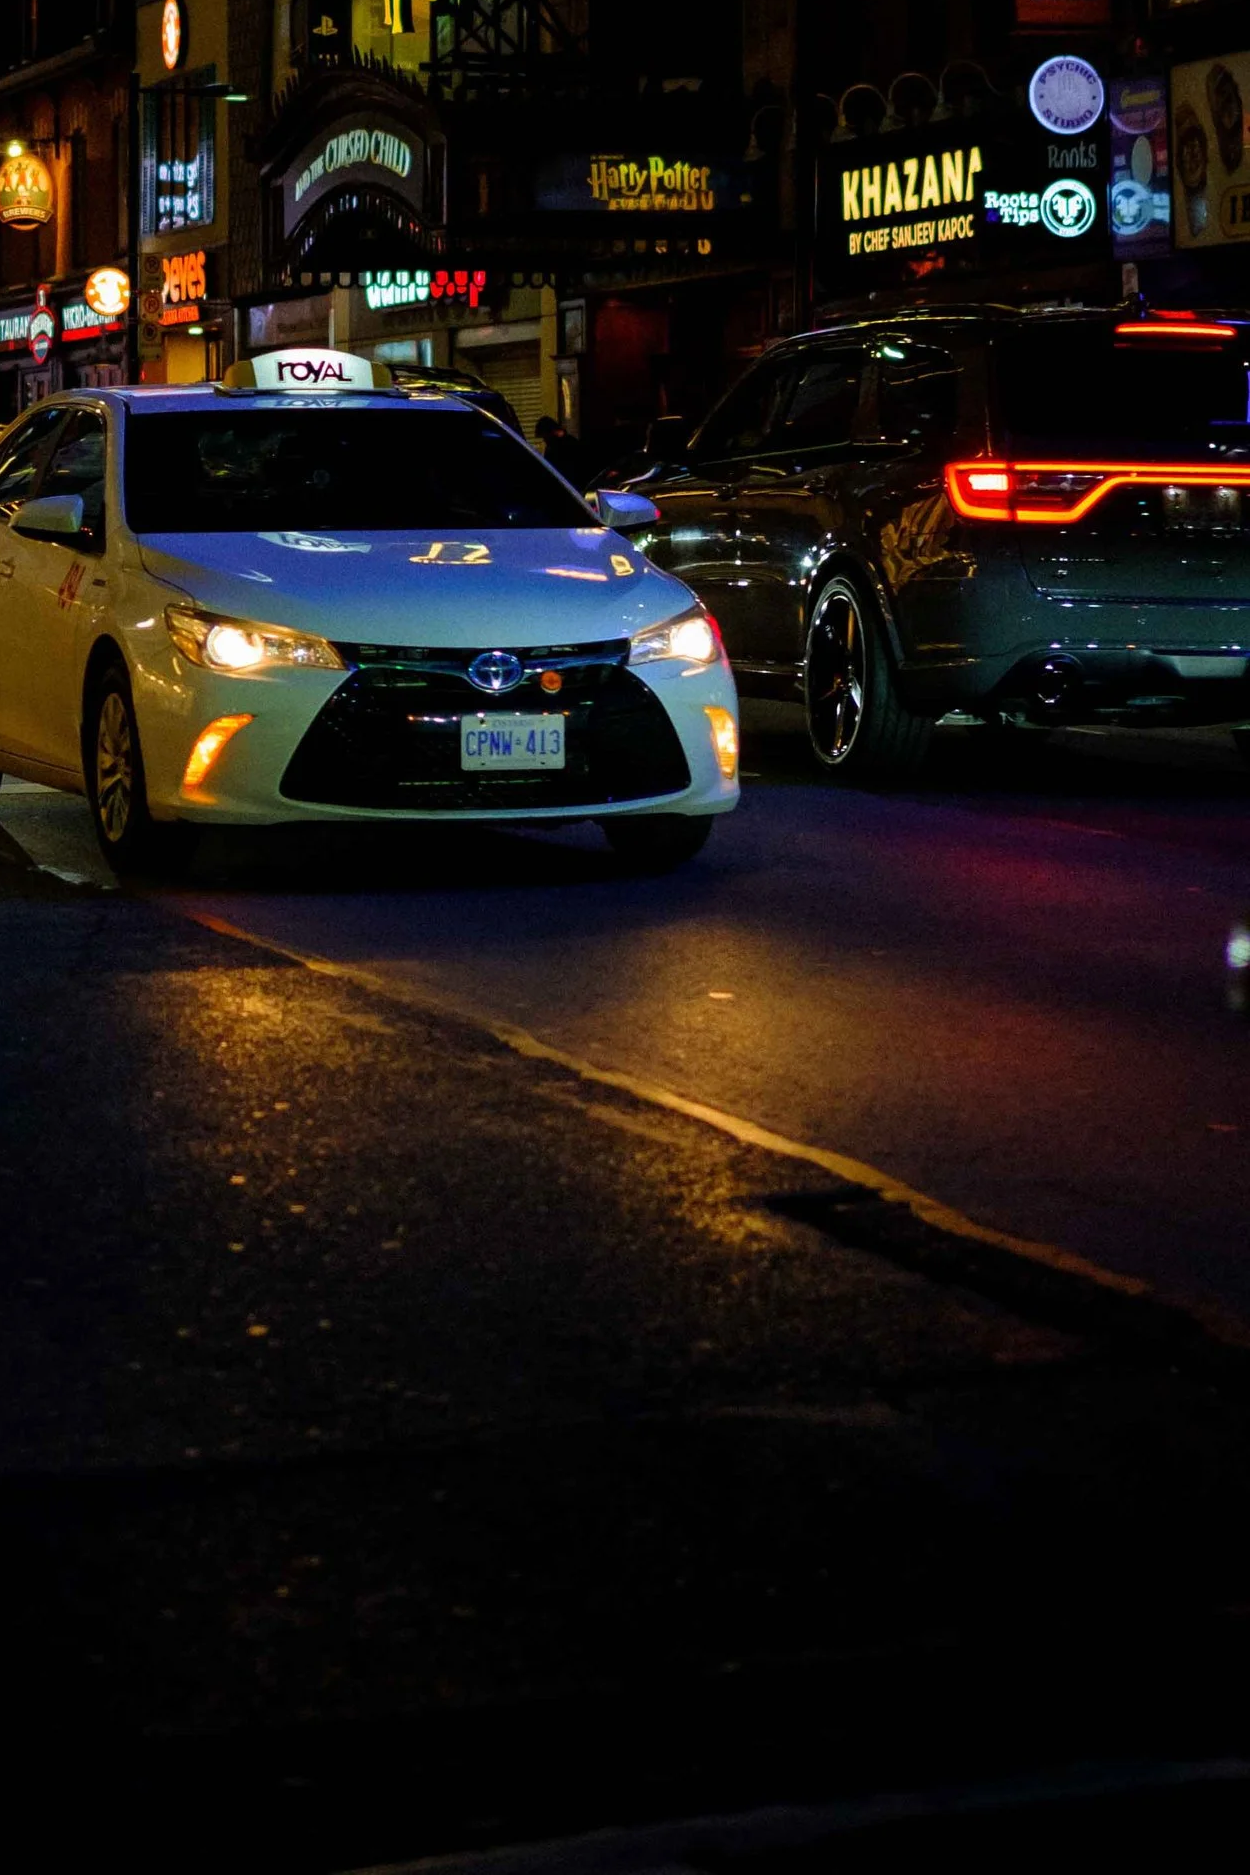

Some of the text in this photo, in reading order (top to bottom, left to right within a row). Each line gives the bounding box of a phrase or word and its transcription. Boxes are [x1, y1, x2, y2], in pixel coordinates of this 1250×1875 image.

[1039, 62, 1097, 85] PSYCHIC
[1042, 107, 1095, 128] STUDIO
[325, 129, 370, 173] CURSED
[370, 129, 412, 178] CHILD
[587, 161, 648, 201] Harry
[648, 155, 712, 204] Potter
[984, 191, 1040, 209] Roots
[2, 208, 46, 219] BREWERS
[1000, 208, 1041, 226] Tips
[849, 231, 863, 255] BY
[863, 227, 890, 253] CHEF
[891, 220, 936, 250] SANJEEV
[466, 729, 561, 756] CPNW 413
